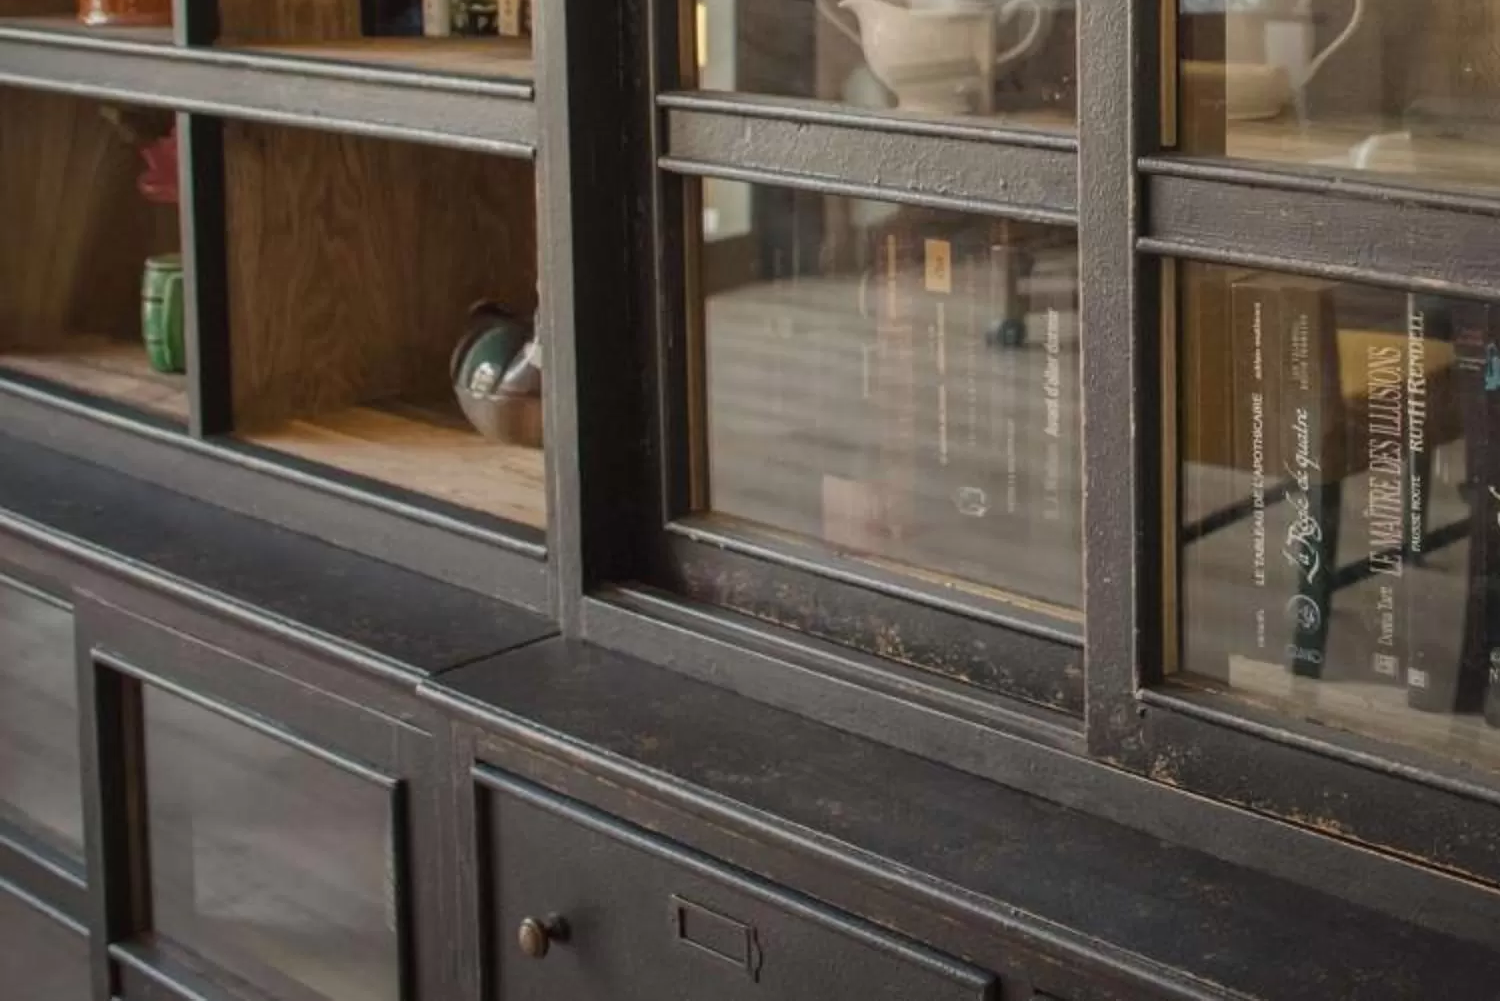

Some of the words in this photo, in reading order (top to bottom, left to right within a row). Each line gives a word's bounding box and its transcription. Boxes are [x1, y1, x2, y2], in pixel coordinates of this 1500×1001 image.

[1407, 311, 1427, 395] RENDELL
[1367, 345, 1403, 437] ILLUSIONS
[1251, 392, 1264, 488] L'APOTHICAIRE
[1291, 408, 1321, 472] quatre
[1407, 400, 1427, 453] RUTH
[1283, 460, 1309, 491] de
[1368, 438, 1401, 476] DES
[1252, 489, 1264, 508] DE
[1362, 476, 1403, 550] MAÎTRE
[1409, 475, 1421, 511] ROUTE
[1253, 510, 1265, 568] TABLEAU
[1369, 550, 1403, 578] LE
[1255, 569, 1265, 586] LE
